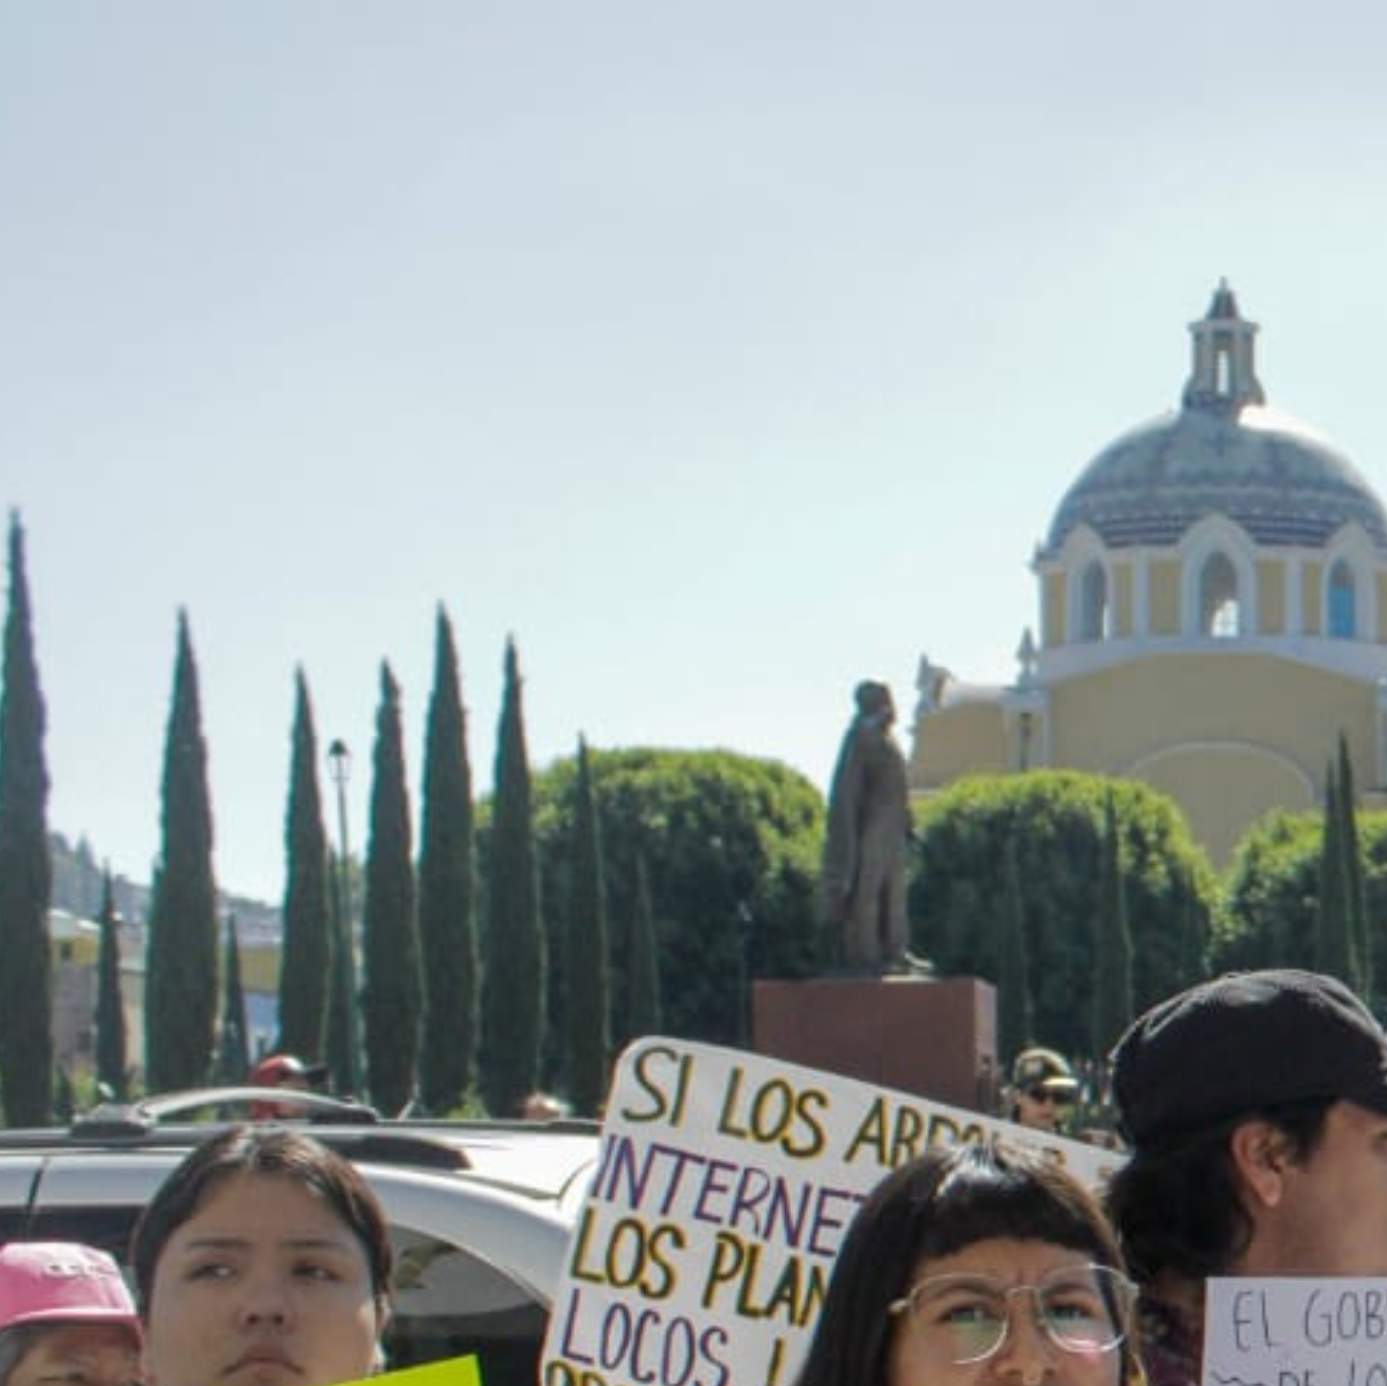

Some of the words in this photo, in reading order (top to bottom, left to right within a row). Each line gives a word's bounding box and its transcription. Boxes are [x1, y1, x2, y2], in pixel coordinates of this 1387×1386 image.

[622, 1045, 696, 1128] SI
[718, 1066, 830, 1164] LOS
[570, 1207, 685, 1302] LOS
[702, 1230, 829, 1328] PLAN
[1232, 1289, 1284, 1353] EL
